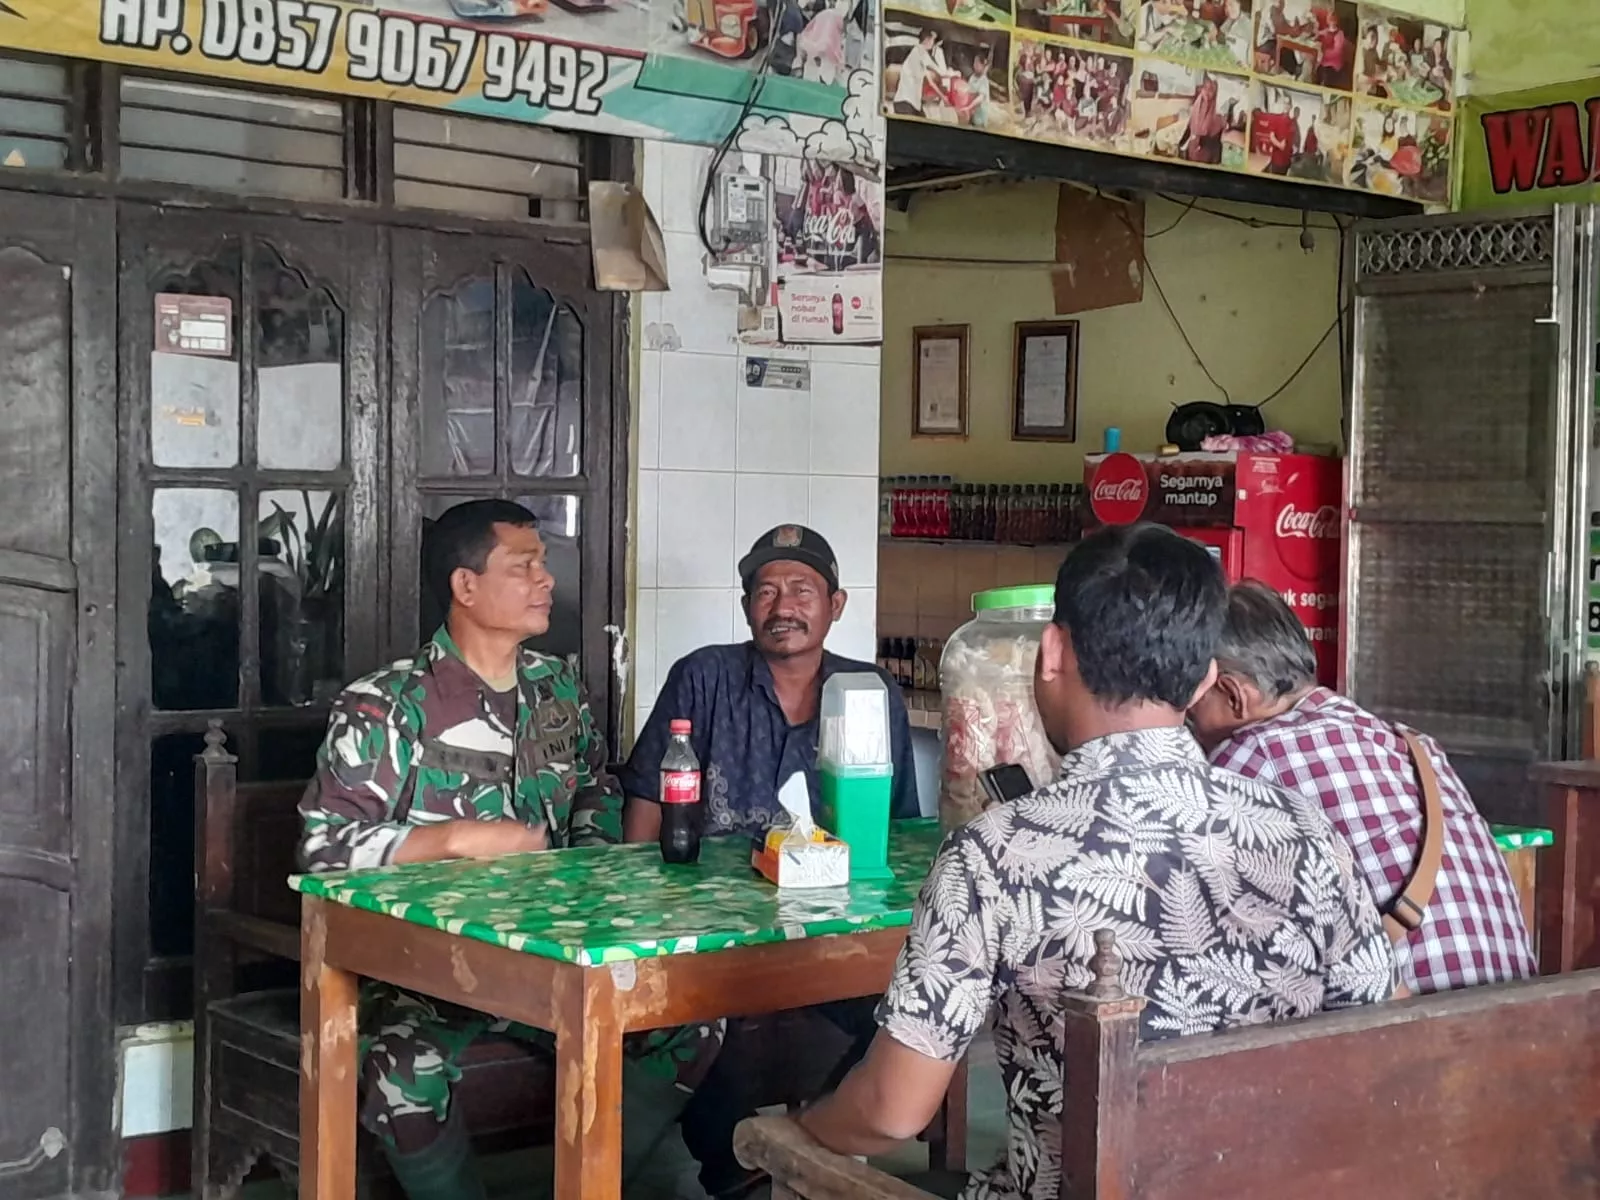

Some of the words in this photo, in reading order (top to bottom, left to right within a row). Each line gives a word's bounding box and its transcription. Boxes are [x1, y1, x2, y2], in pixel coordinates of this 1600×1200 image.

[200, 0, 341, 74] 0857
[346, 9, 482, 94] 9067
[483, 31, 610, 116] 9492
[1160, 474, 1223, 491] Segarnya
[1165, 491, 1217, 506] mantap
